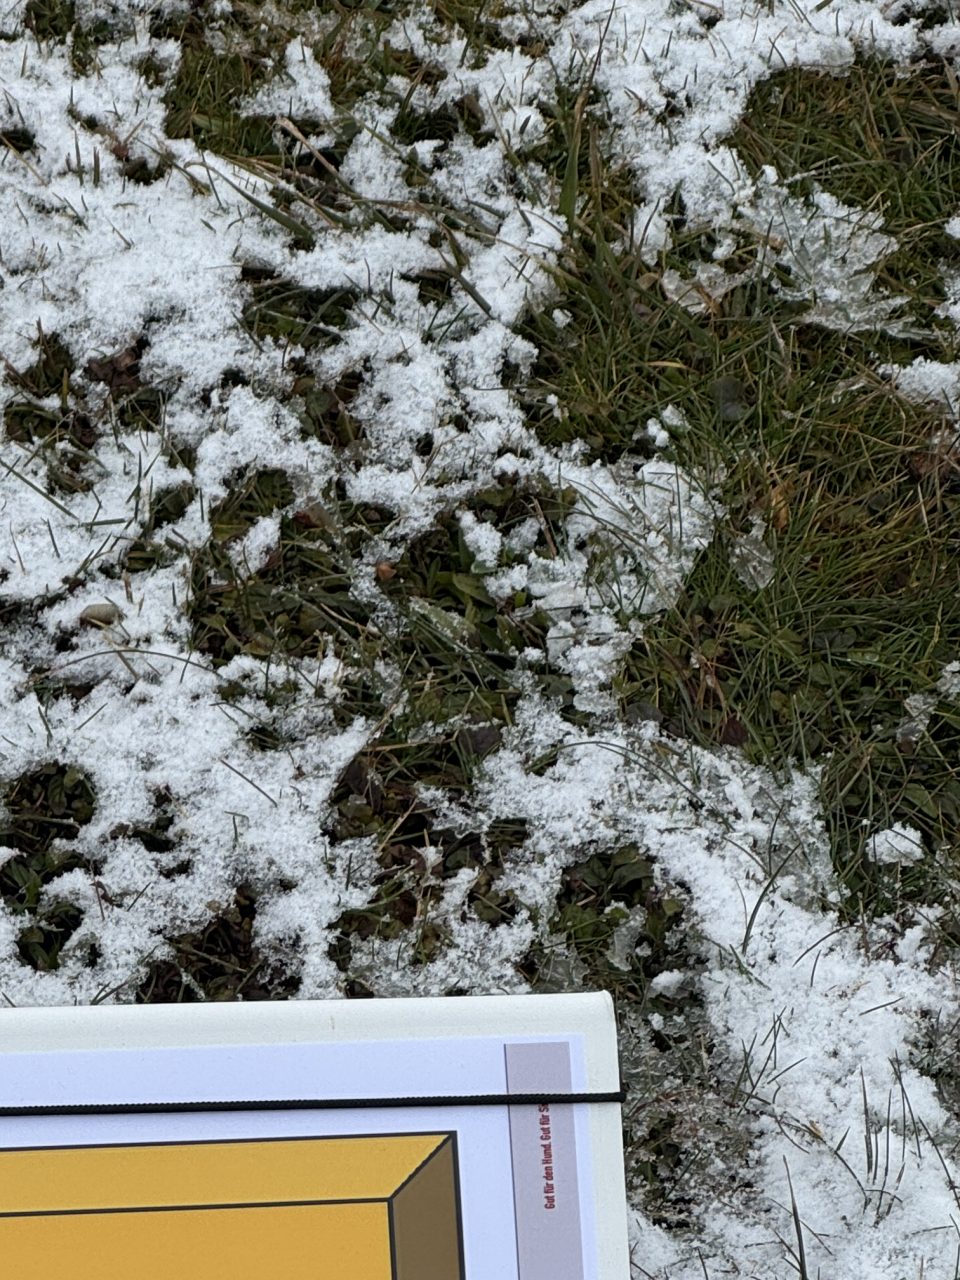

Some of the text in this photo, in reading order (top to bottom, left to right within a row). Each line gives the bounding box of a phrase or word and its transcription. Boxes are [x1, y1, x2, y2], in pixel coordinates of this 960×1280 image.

[539, 1114, 550, 1126] für
[540, 1127, 551, 1141] Gut
[541, 1142, 552, 1165] Hund.
[543, 1166, 554, 1181] den
[544, 1182, 555, 1194] für
[544, 1195, 555, 1209] Gut
